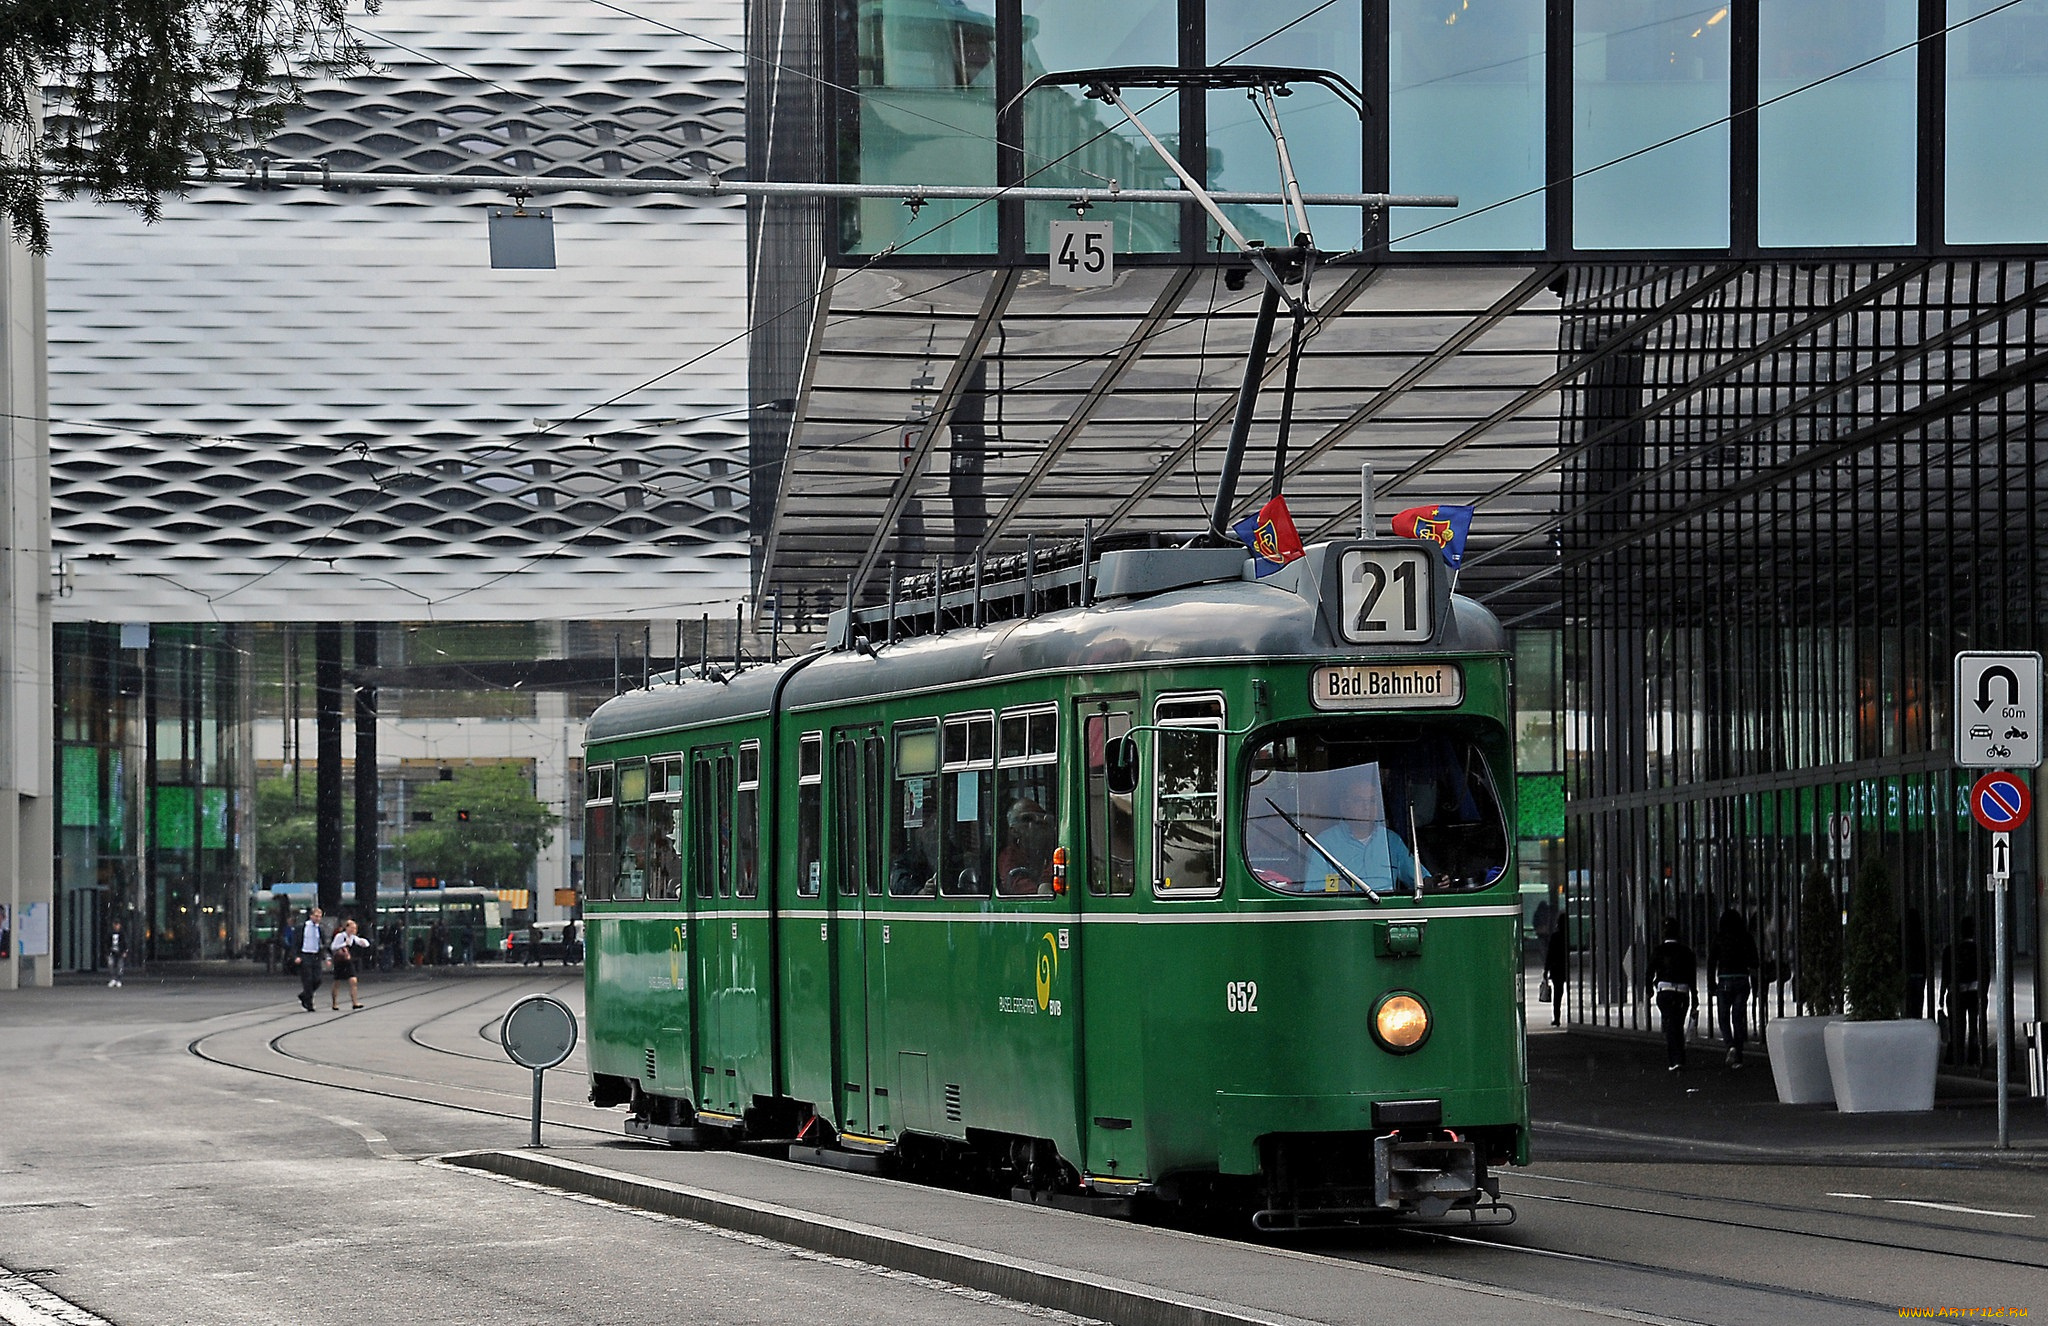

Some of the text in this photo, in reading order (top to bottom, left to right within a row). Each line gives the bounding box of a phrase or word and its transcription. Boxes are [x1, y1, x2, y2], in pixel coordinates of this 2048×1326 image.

[1057, 232, 1105, 273] 45
[1351, 560, 1417, 632] 21
[2001, 707, 2026, 719] 60m
[1049, 999, 1062, 1017] BVB
[1227, 981, 1258, 1012] 652
